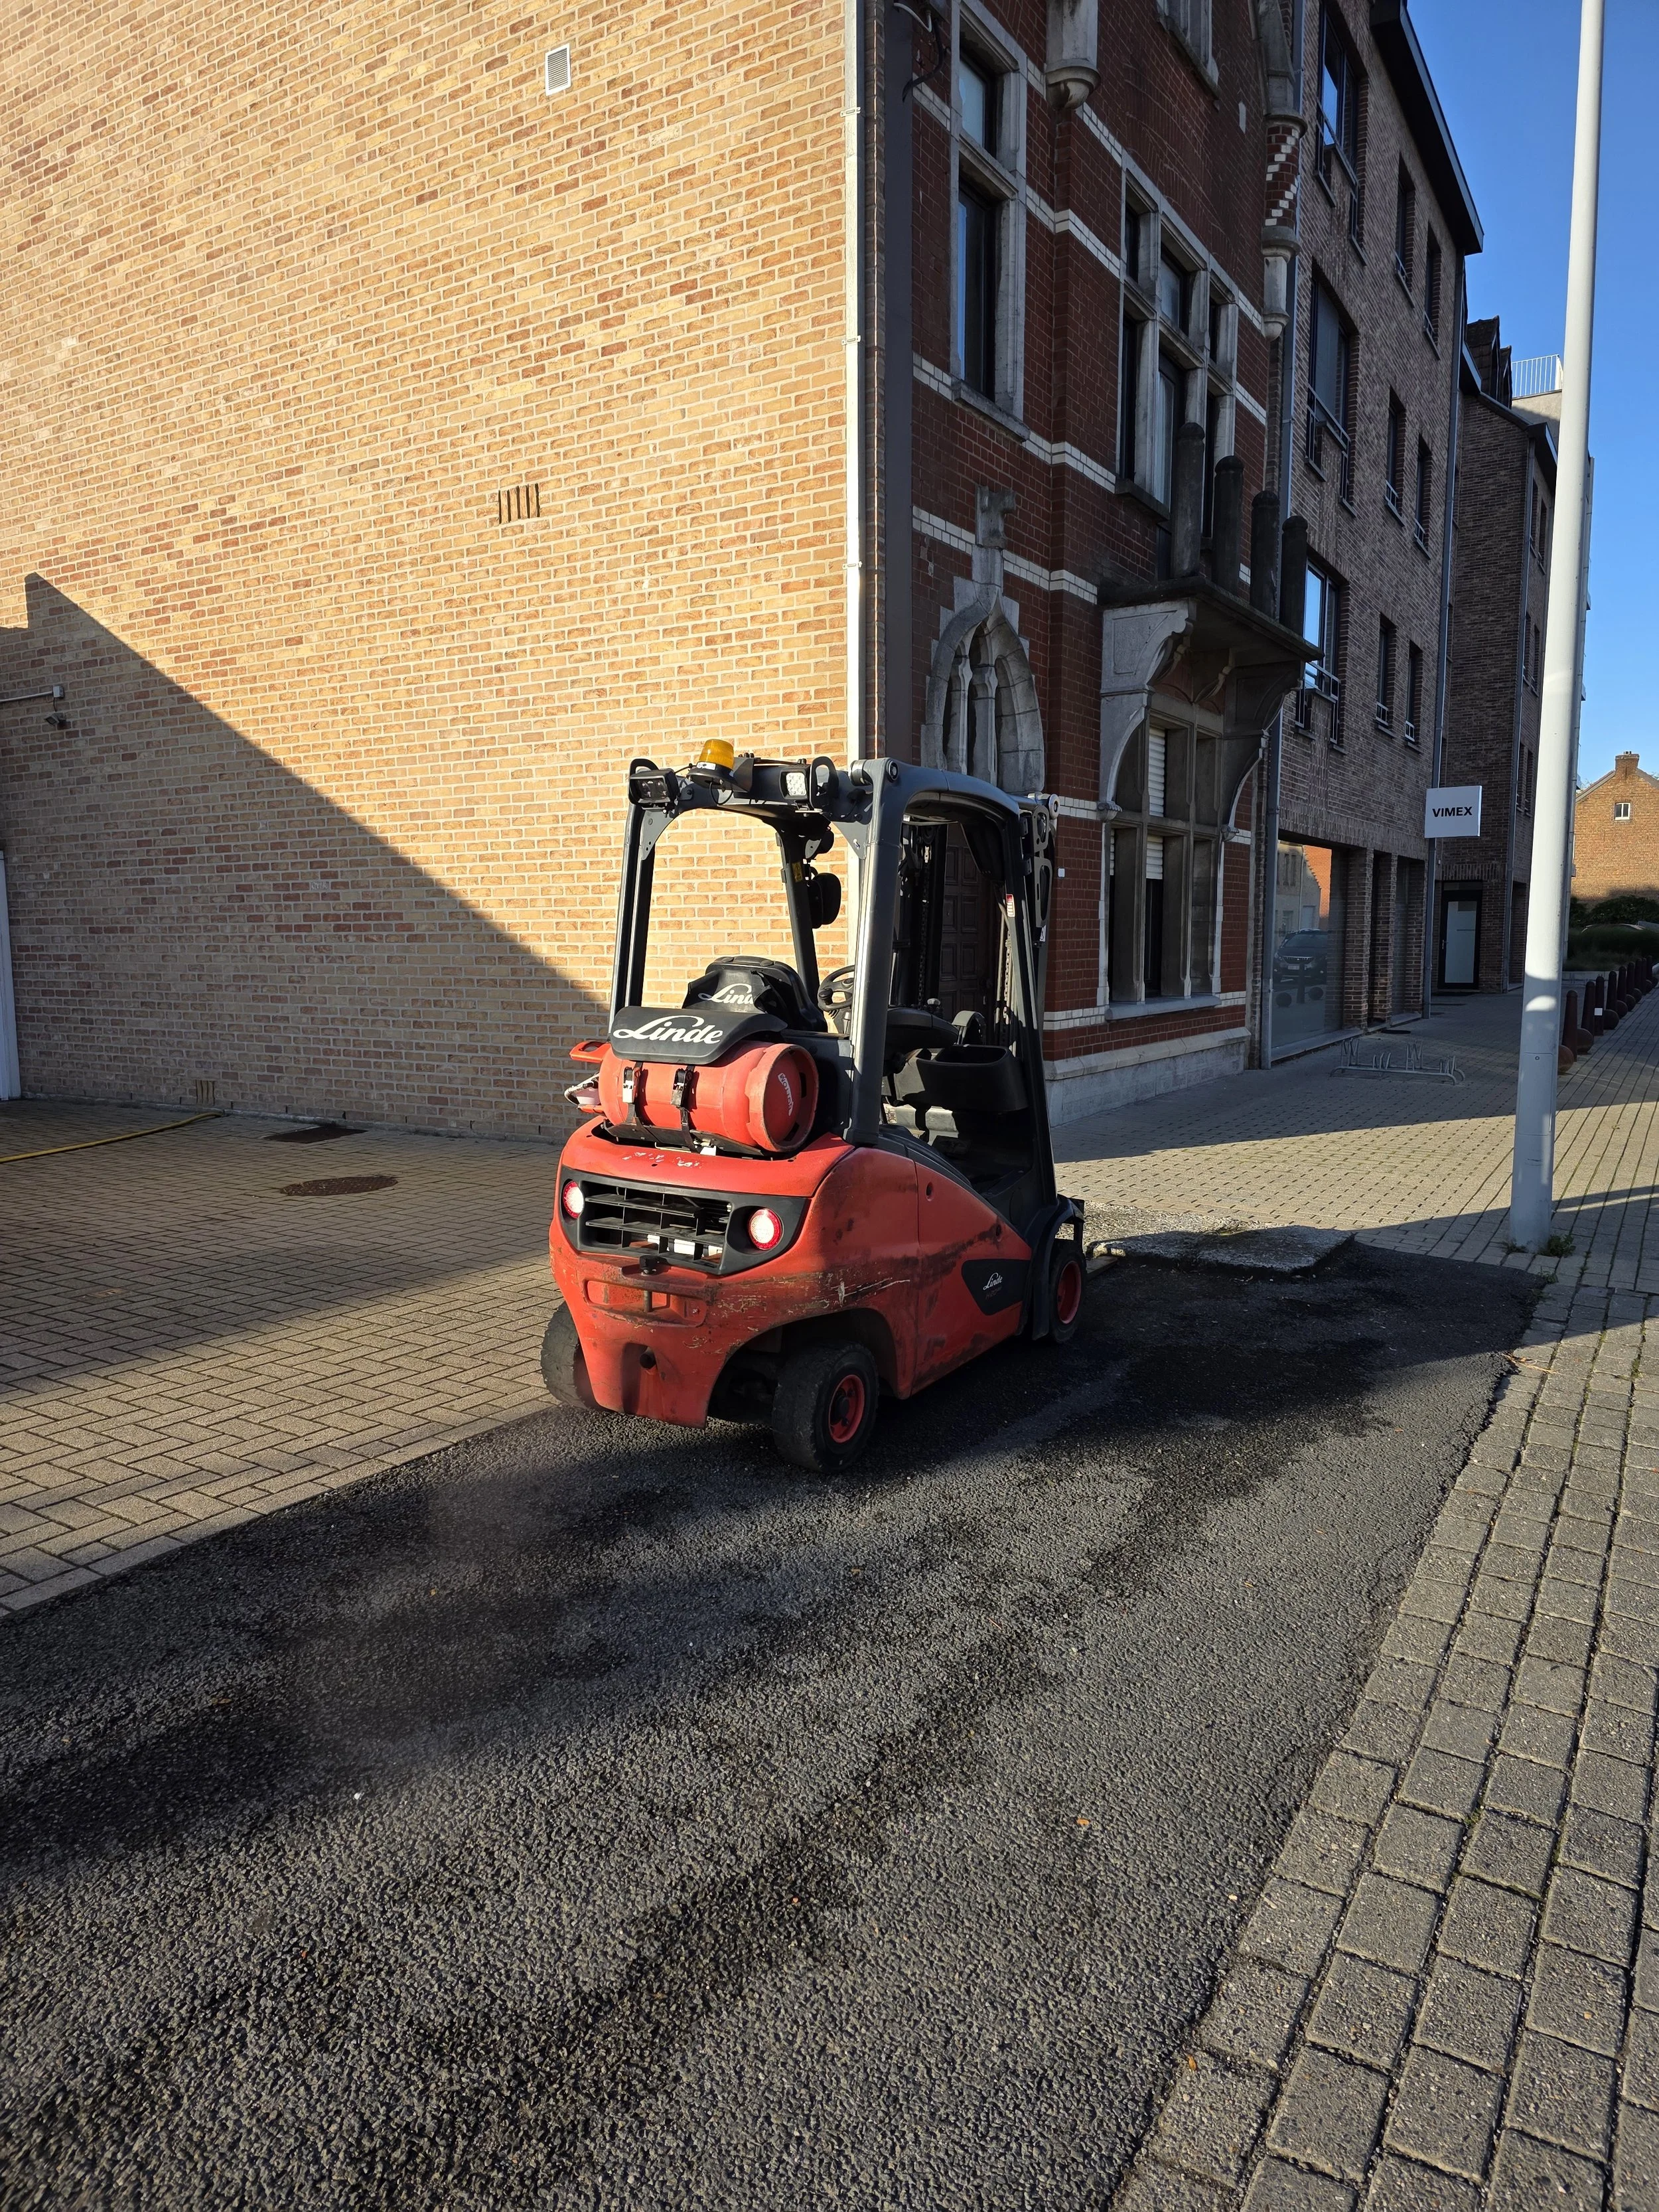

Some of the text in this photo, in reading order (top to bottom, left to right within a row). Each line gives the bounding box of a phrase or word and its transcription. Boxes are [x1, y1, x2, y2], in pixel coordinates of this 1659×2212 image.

[1432, 806, 1473, 818] VIMEX
[613, 1015, 723, 1044] Linde
[983, 1272, 1003, 1290] Linde
